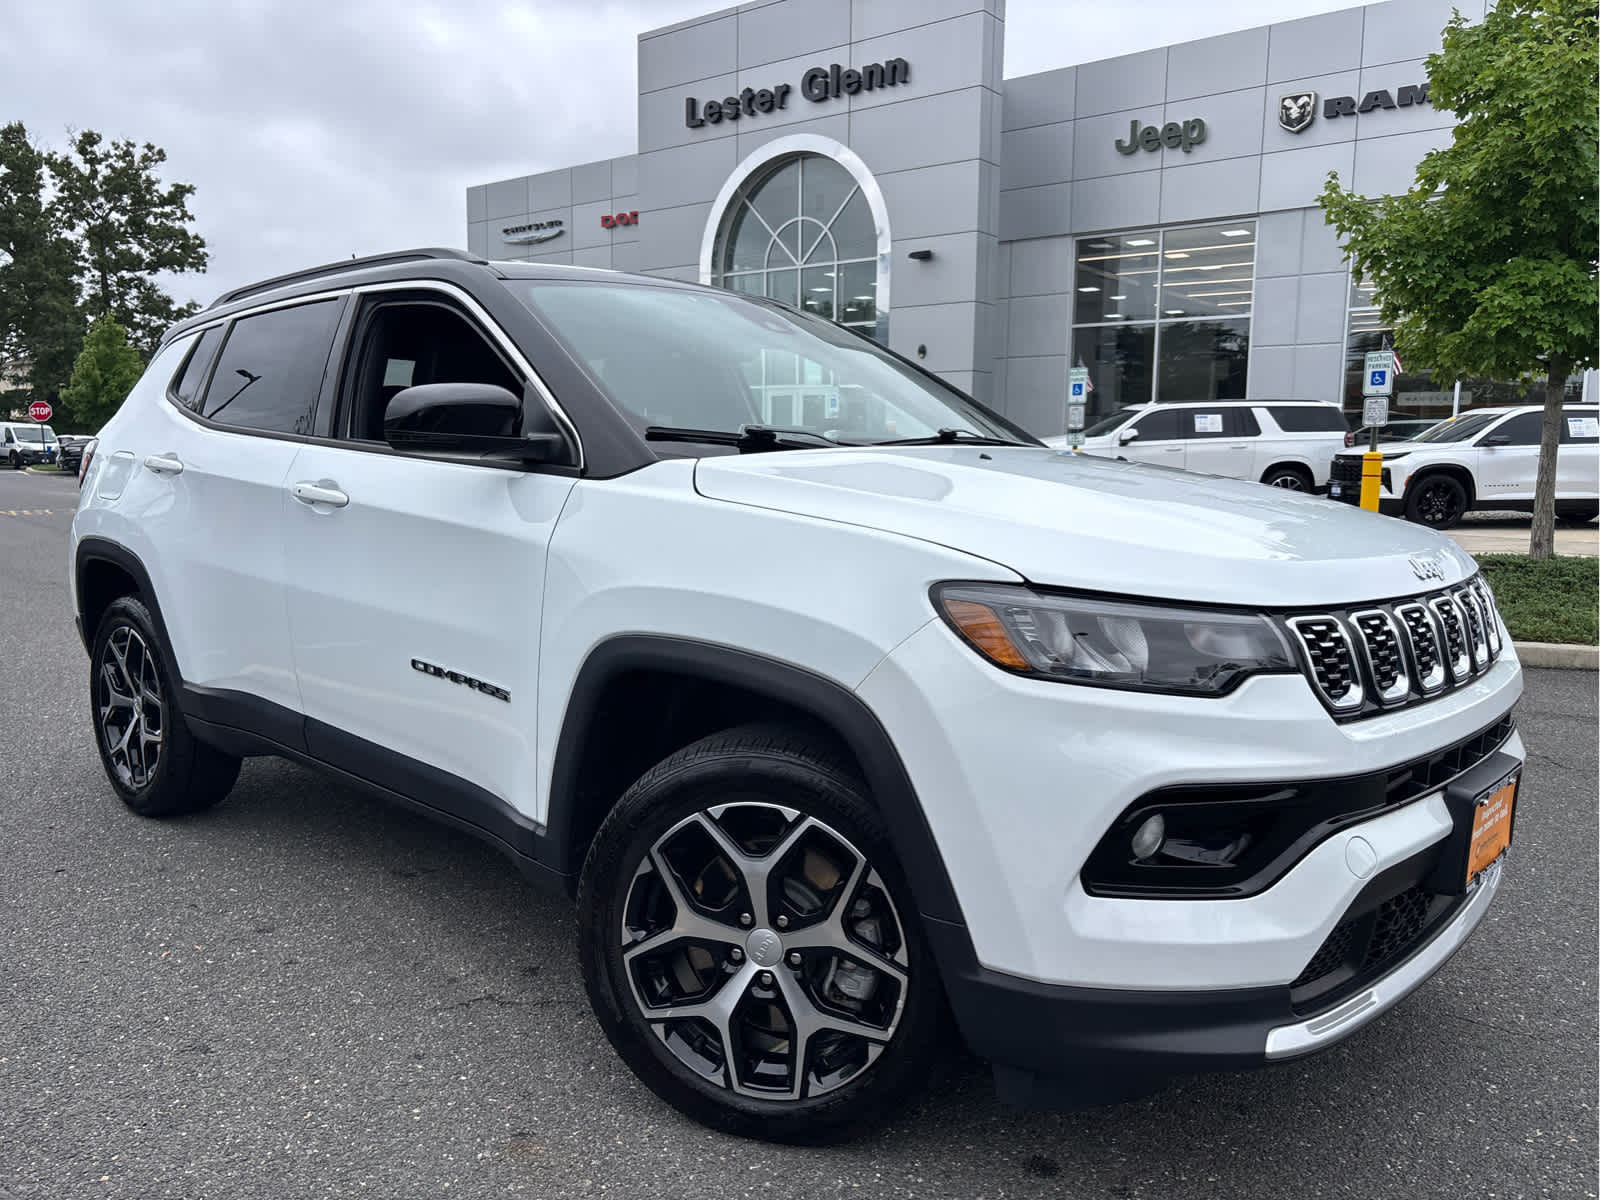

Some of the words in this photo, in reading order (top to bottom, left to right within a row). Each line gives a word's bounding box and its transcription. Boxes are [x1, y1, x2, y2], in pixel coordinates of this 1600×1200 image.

[685, 83, 793, 129] Lester
[801, 57, 909, 103] Glenn
[1323, 83, 1433, 118] RAM
[1115, 118, 1207, 155] Jeep
[30, 407, 50, 416] STOP
[410, 658, 511, 703] COMPASS
